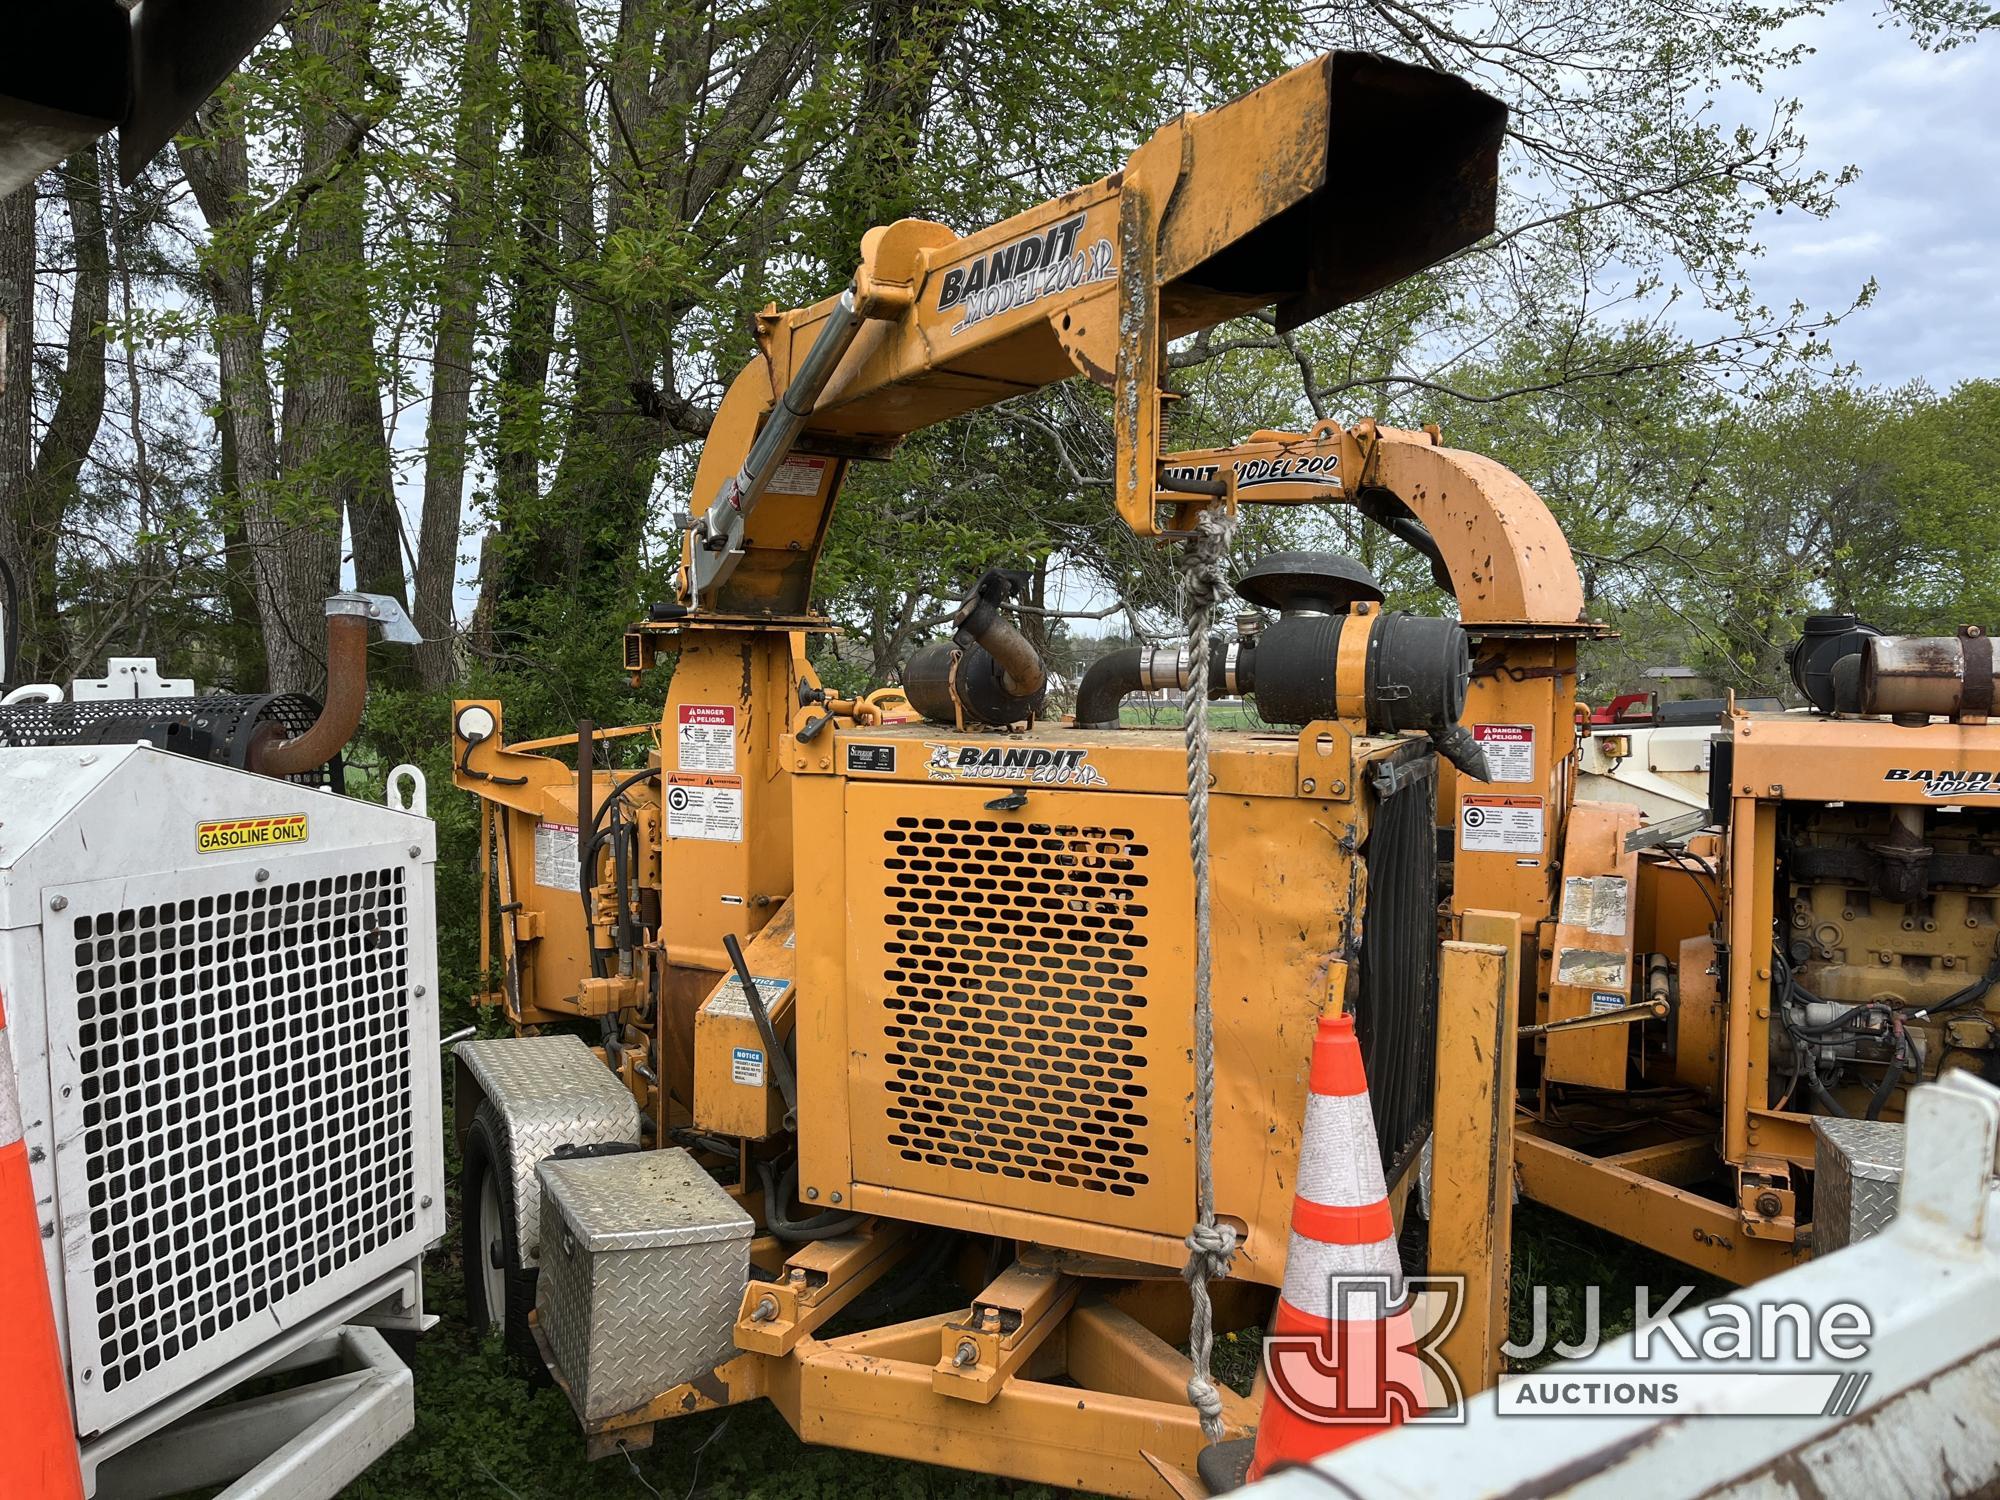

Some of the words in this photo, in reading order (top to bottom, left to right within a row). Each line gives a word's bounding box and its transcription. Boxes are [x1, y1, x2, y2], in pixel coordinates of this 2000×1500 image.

[937, 212, 1086, 309] BANDIT
[963, 269, 1037, 325] MODEL
[1042, 250, 1085, 297] 200
[1233, 459, 1291, 482] MODEL
[1295, 454, 1338, 475] 200
[696, 708, 725, 716] DANGER
[696, 716, 726, 724] PELIGRO
[956, 747, 1088, 769] BANDIT
[962, 765, 1026, 780] MODEL
[1031, 766, 1071, 784] 200
[1074, 767, 1098, 785] XP
[1922, 780, 1991, 794] MODEL
[200, 828, 269, 848] GASOLINE
[272, 824, 305, 840] ONLY
[1596, 995, 1621, 1003] NOTICE
[736, 1051, 760, 1060] NOTICE
